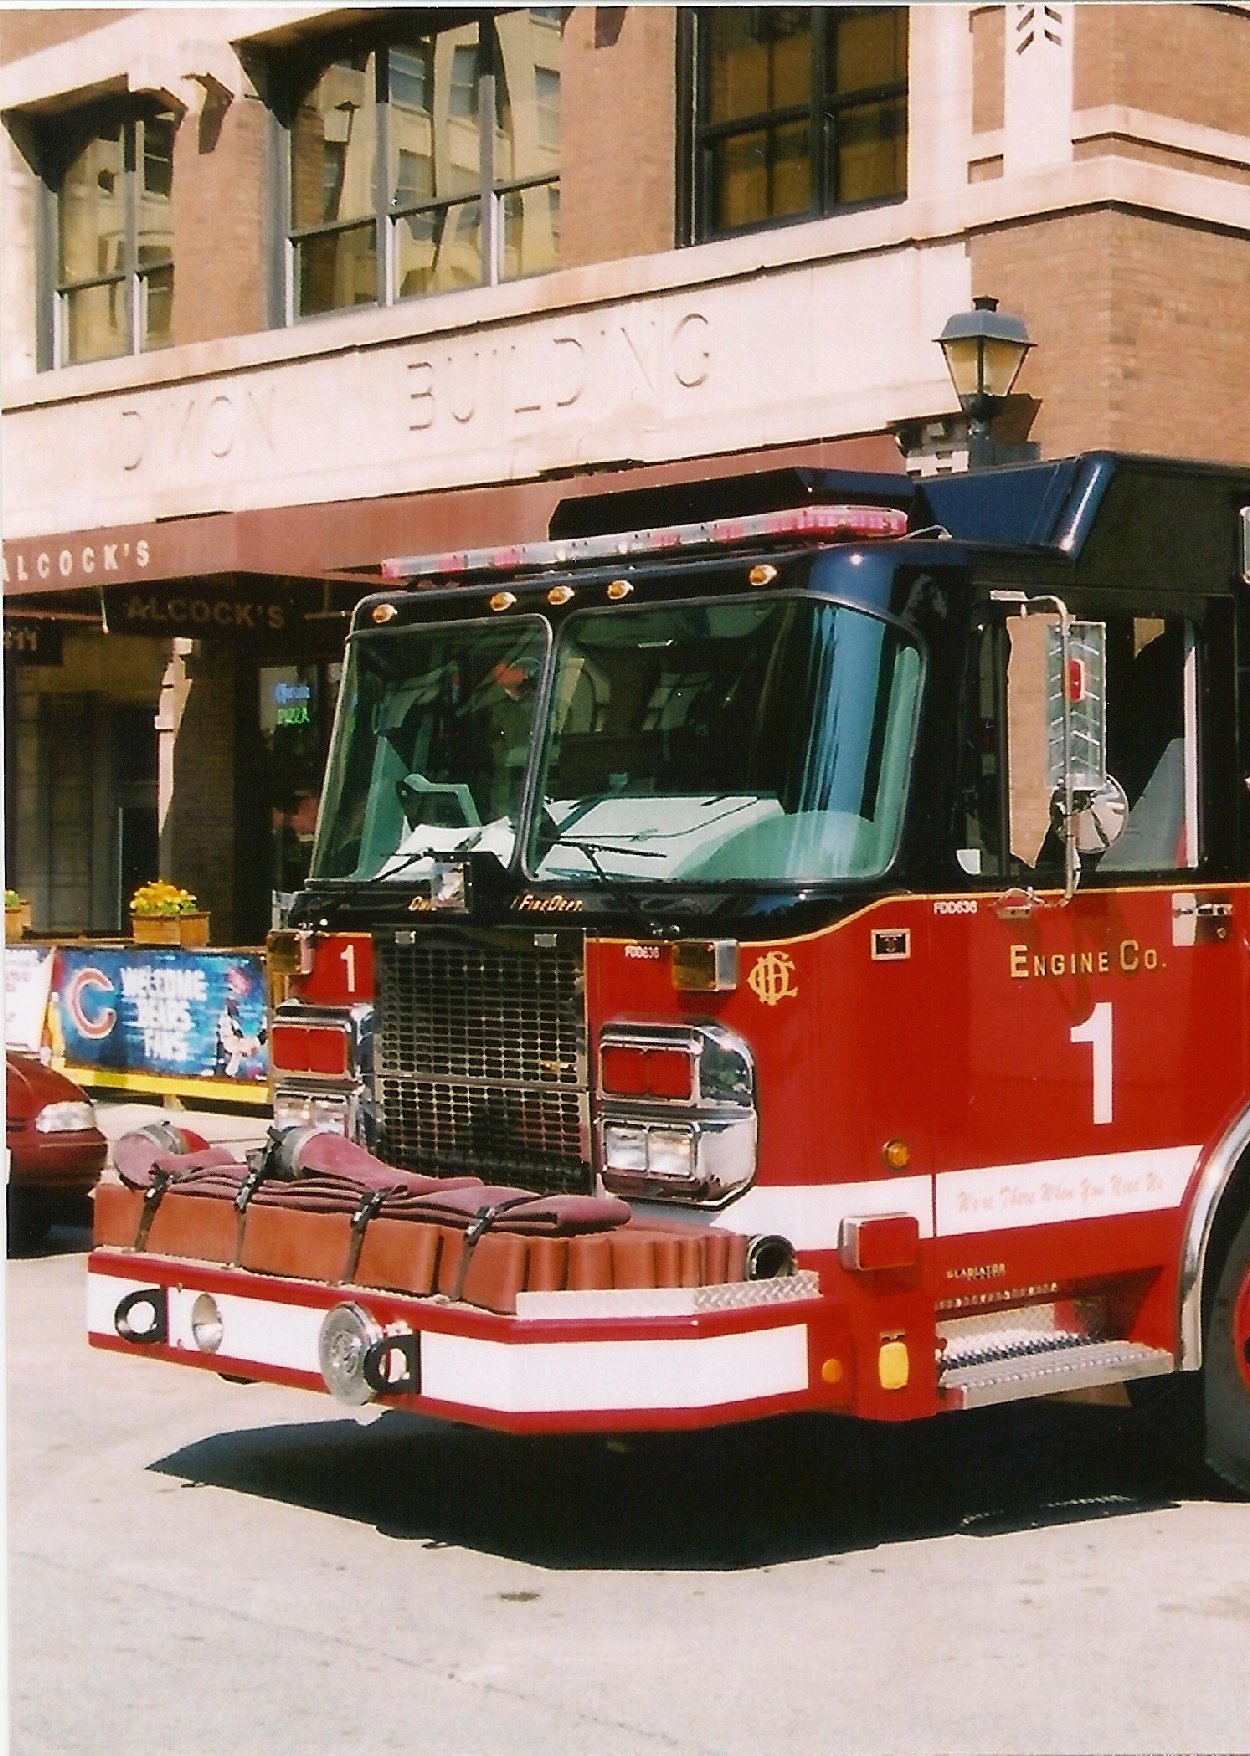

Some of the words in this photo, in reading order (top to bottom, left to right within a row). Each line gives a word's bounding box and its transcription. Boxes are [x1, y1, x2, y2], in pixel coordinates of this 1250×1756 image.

[407, 313, 710, 431] BUILDING
[126, 596, 286, 629] ALCOCK'S
[340, 944, 356, 993] 1
[1010, 944, 1109, 978] ENGINE
[1119, 939, 1168, 971] CO.
[1069, 1001, 1113, 1125] 1
